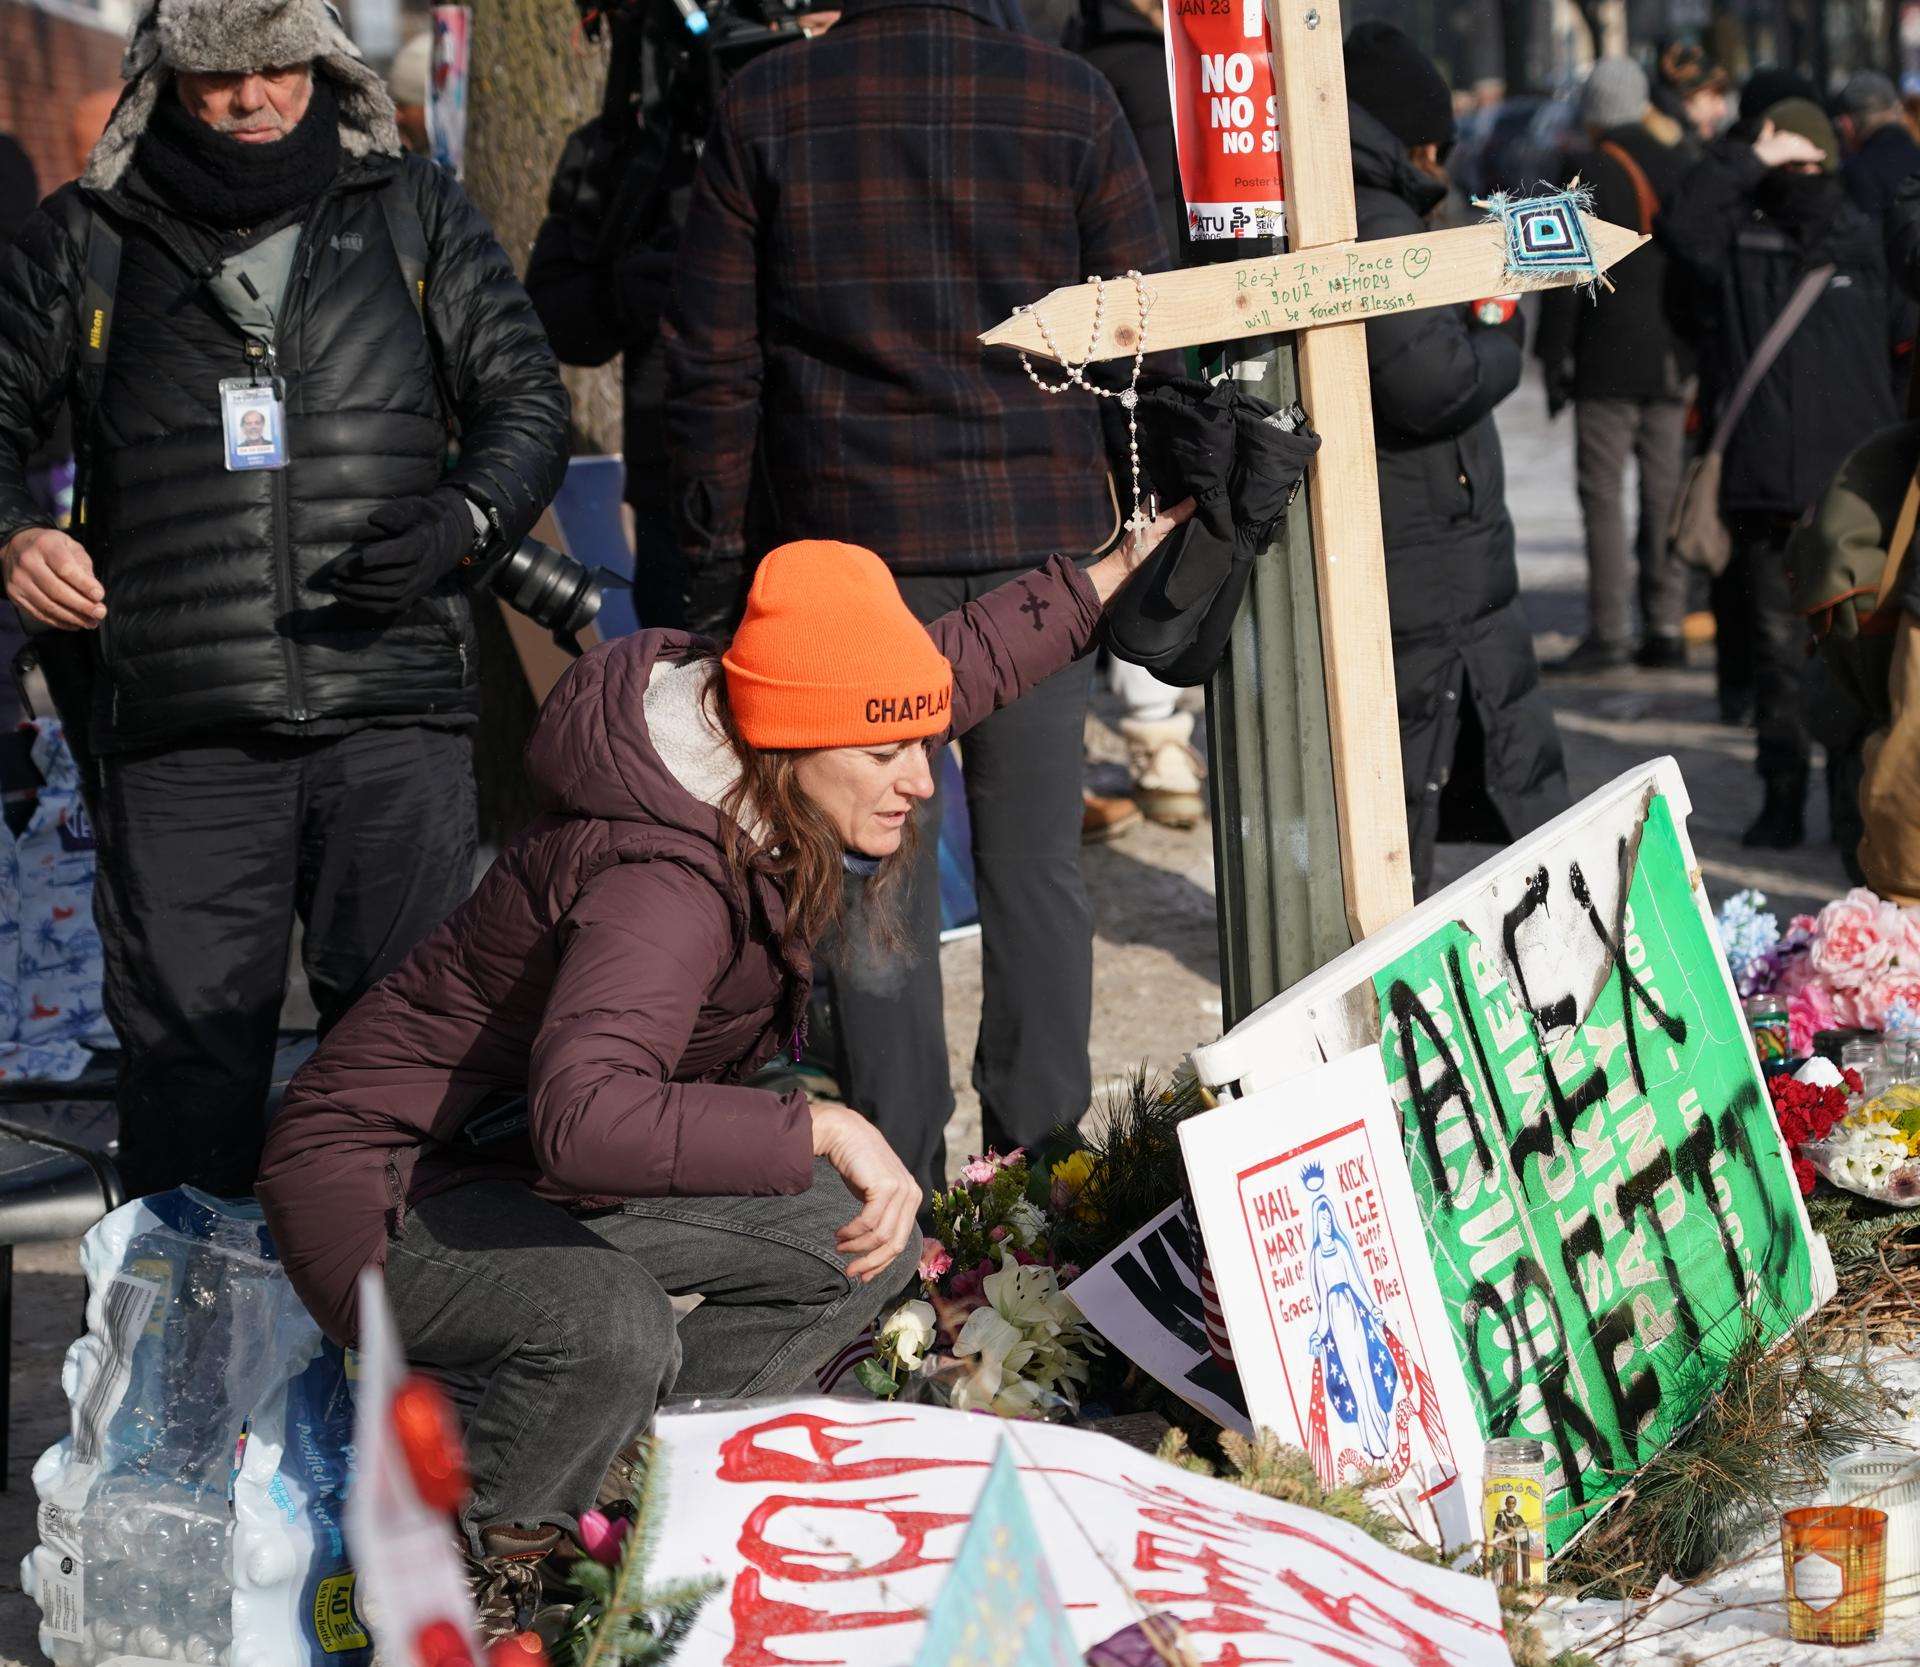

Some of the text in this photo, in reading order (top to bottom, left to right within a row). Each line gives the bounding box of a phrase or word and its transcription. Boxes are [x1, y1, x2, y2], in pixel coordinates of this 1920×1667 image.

[1177, 0, 1230, 15] JAN 23
[1201, 52, 1254, 93] NO
[1211, 96, 1255, 128] NO
[1222, 131, 1255, 154] NO
[1234, 177, 1269, 188] Poster
[1198, 217, 1225, 232] ATU
[1235, 266, 1280, 291] Rest
[1346, 254, 1394, 275] Peace
[90, 308, 104, 349] Nikon
[1245, 310, 1271, 329] will
[1285, 308, 1300, 322] be
[1336, 1154, 1369, 1193] KICK
[1253, 1186, 1299, 1231] HAIL
[1264, 1223, 1306, 1267] MARY
[1363, 1246, 1388, 1275] This
[1271, 1266, 1295, 1292] Full
[296, 1423, 334, 1483] Purified
[332, 1586, 351, 1616] 40
